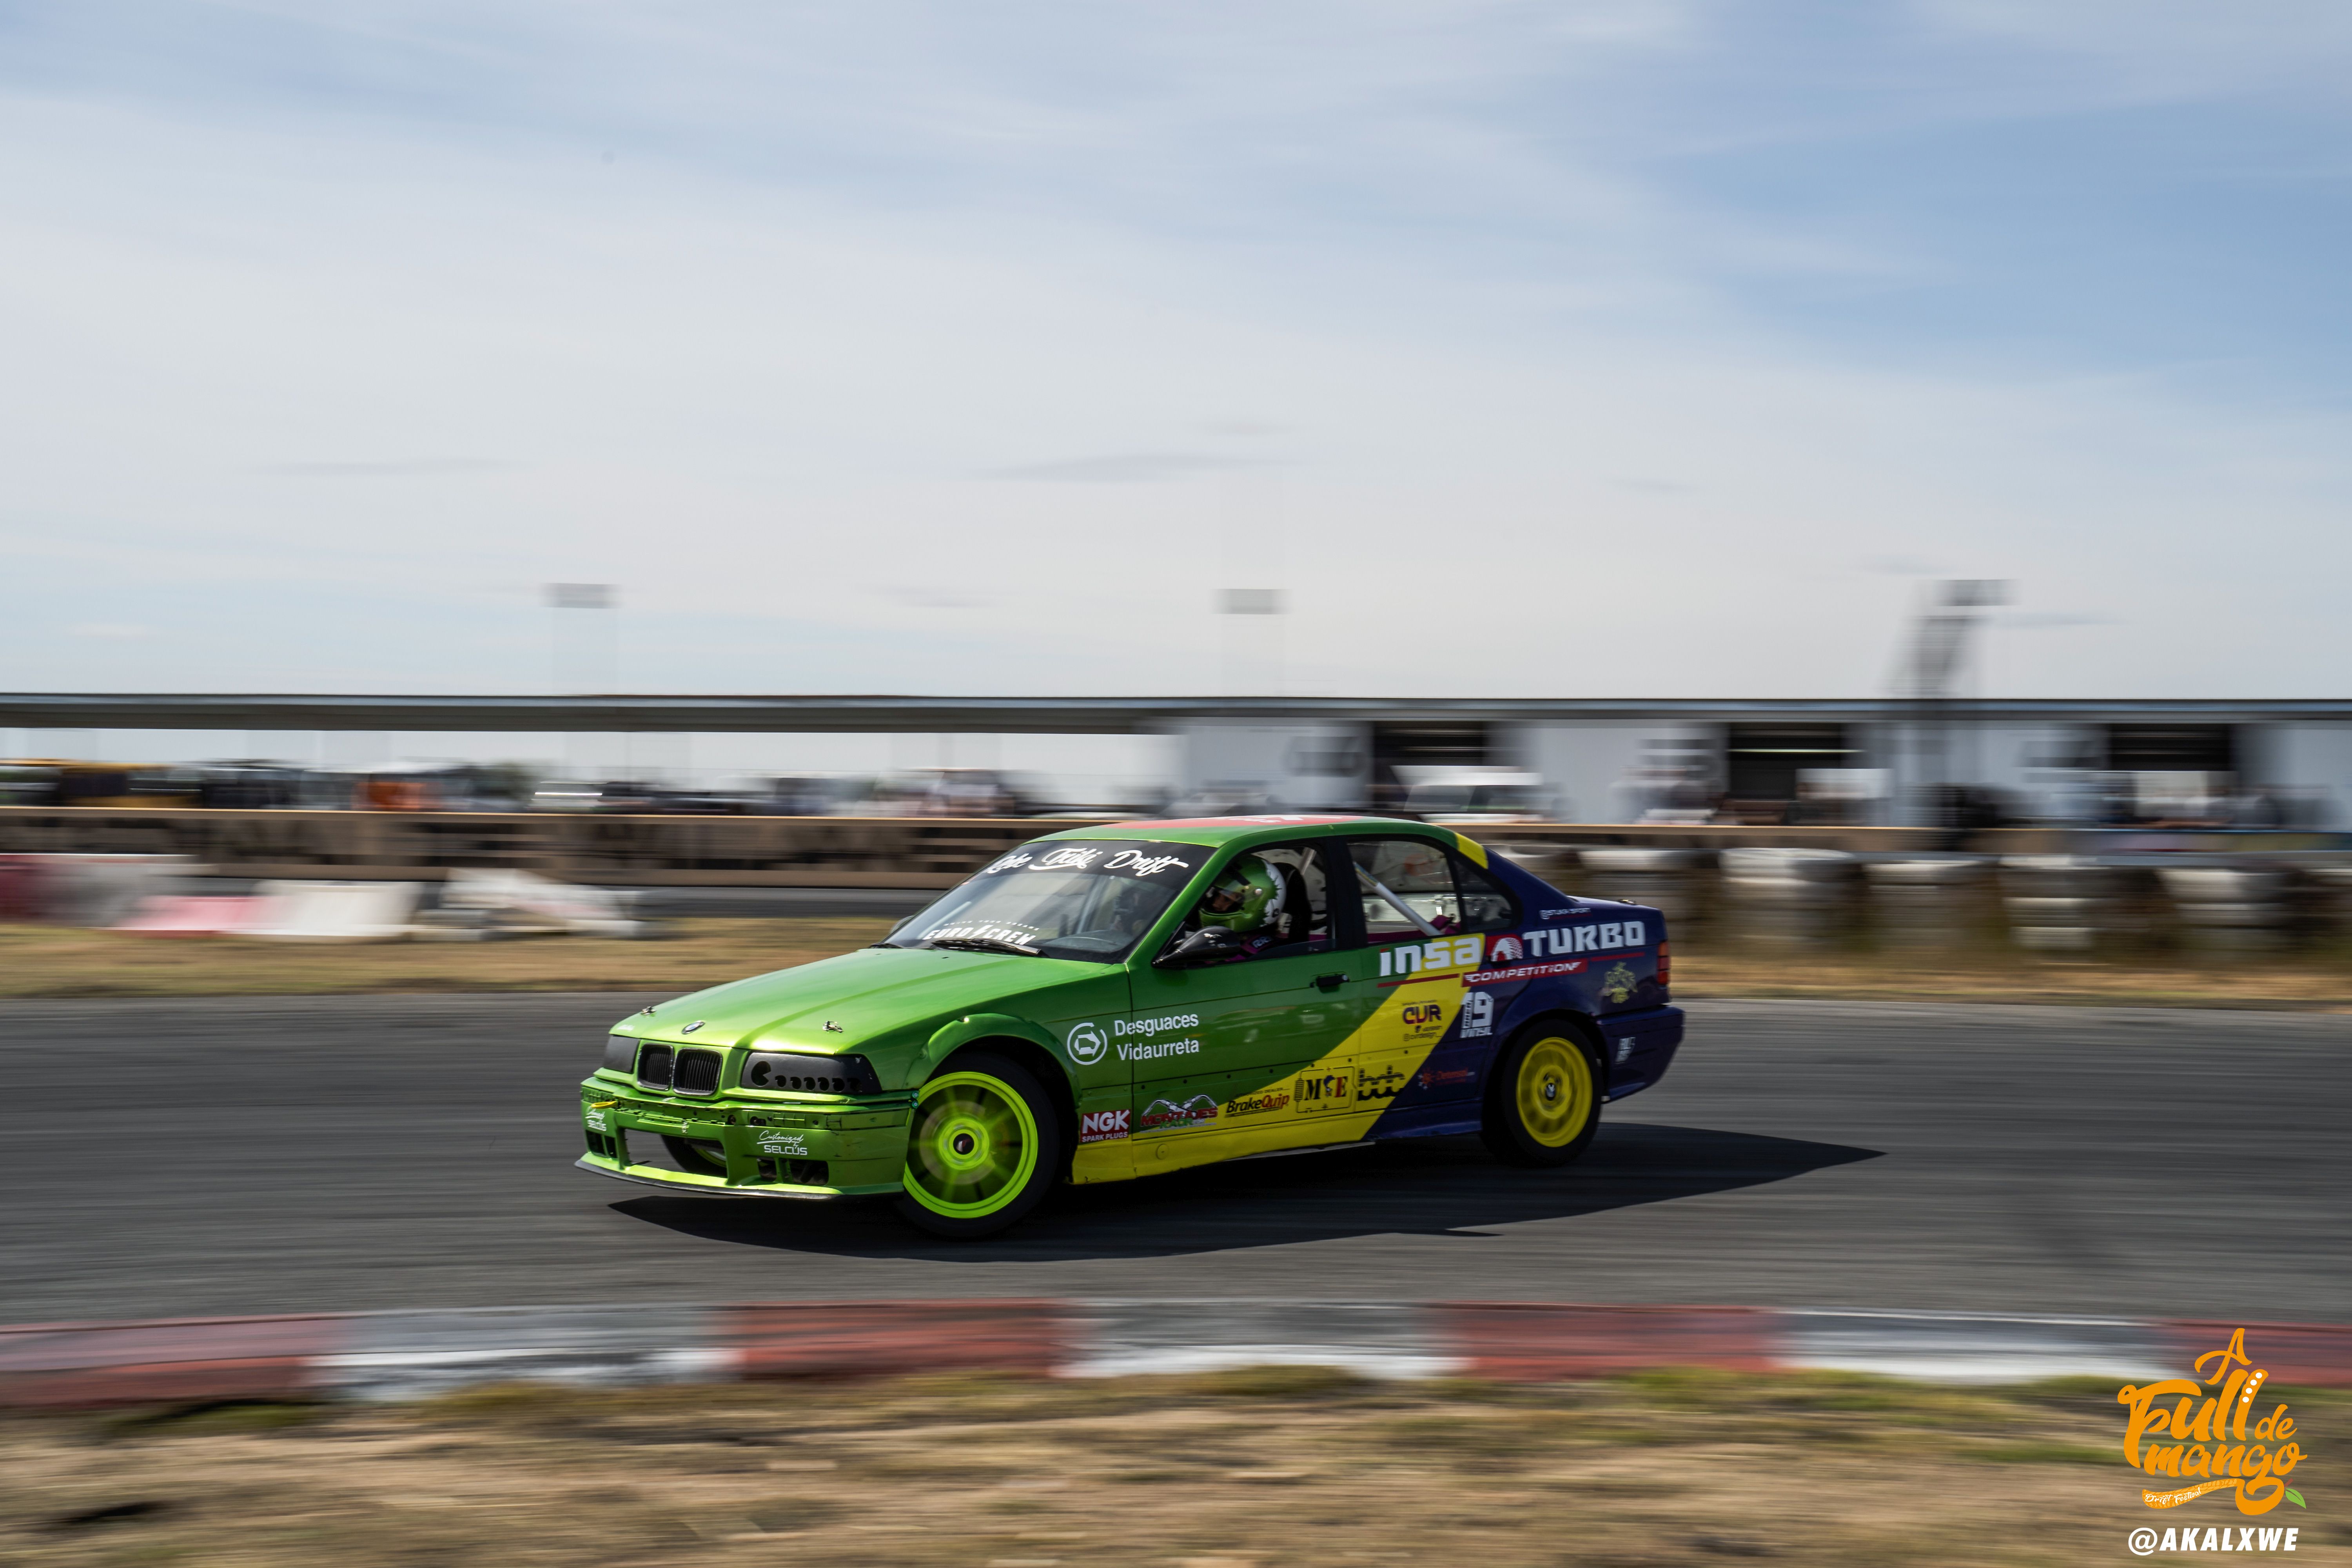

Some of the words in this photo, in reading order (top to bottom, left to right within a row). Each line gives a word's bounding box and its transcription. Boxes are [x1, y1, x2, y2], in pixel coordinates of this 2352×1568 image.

[1104, 850, 1189, 877] Drift
[922, 927, 975, 940] EURO
[983, 928, 1036, 945] CREW
[1523, 920, 1646, 956] TURBO
[1114, 1014, 1199, 1036] Desguaces
[1117, 1038, 1200, 1061] Vidaurreta
[1226, 1093, 1290, 1113] BrakeQuip
[1082, 1109, 1130, 1134] NGK
[1141, 1107, 1218, 1127] MONTAJES
[759, 1130, 804, 1143] Customized
[1082, 1134, 1104, 1142] SPARK
[1106, 1131, 1128, 1140] PLUGS
[764, 1145, 808, 1156] SELCUS
